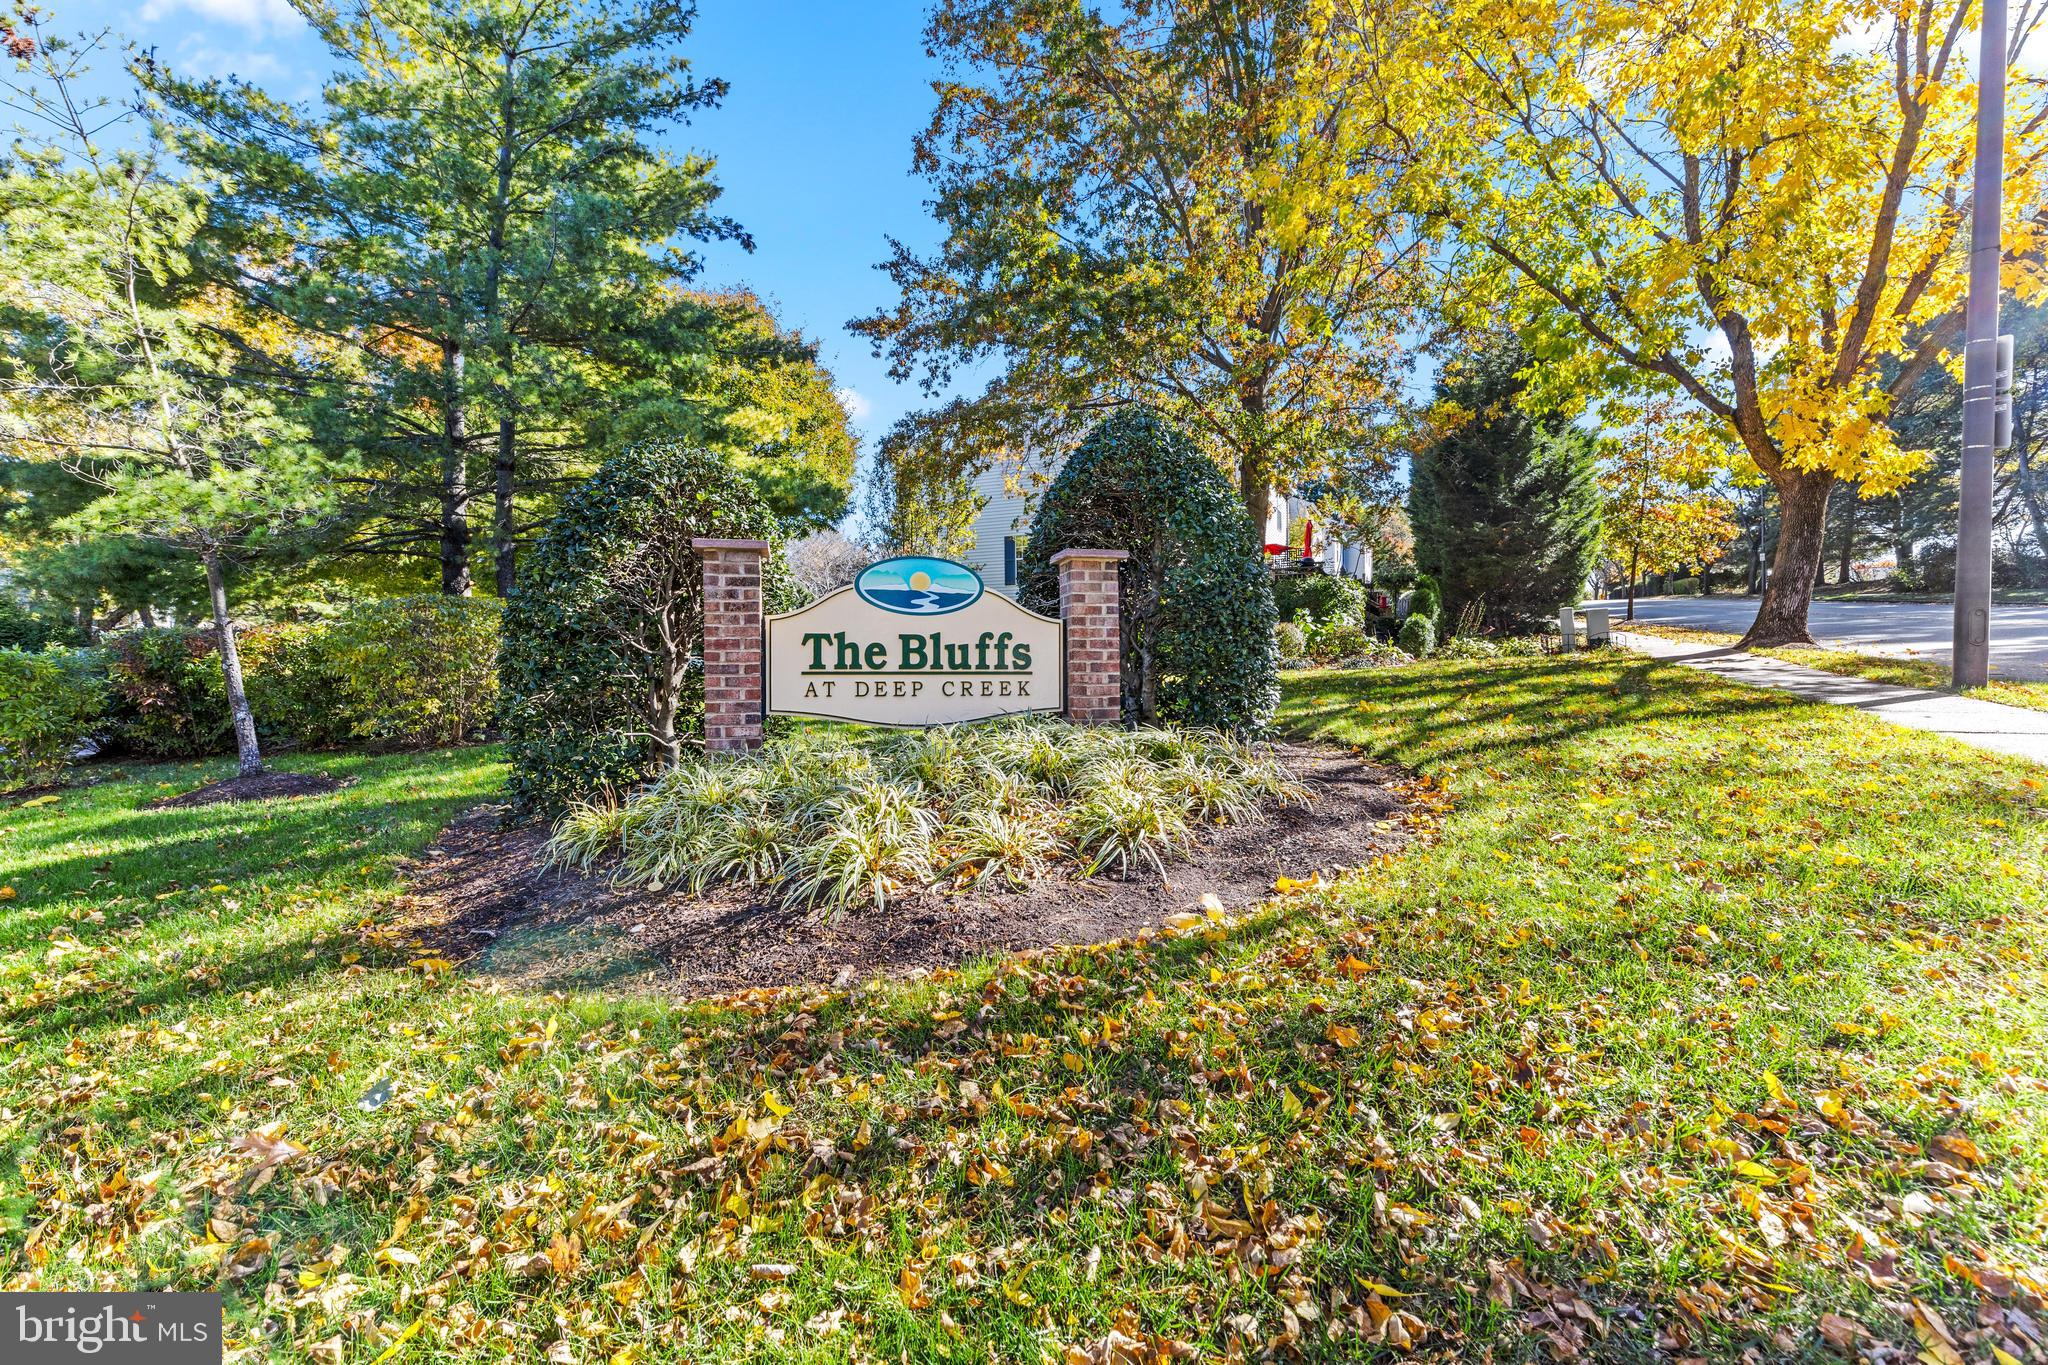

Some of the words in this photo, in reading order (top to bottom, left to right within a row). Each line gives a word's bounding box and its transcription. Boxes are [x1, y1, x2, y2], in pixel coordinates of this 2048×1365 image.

[801, 631, 887, 670] The
[898, 631, 1032, 670] Bluffs
[804, 681, 836, 698] AT
[855, 681, 923, 697] DEEP
[942, 680, 1030, 696] CREEK
